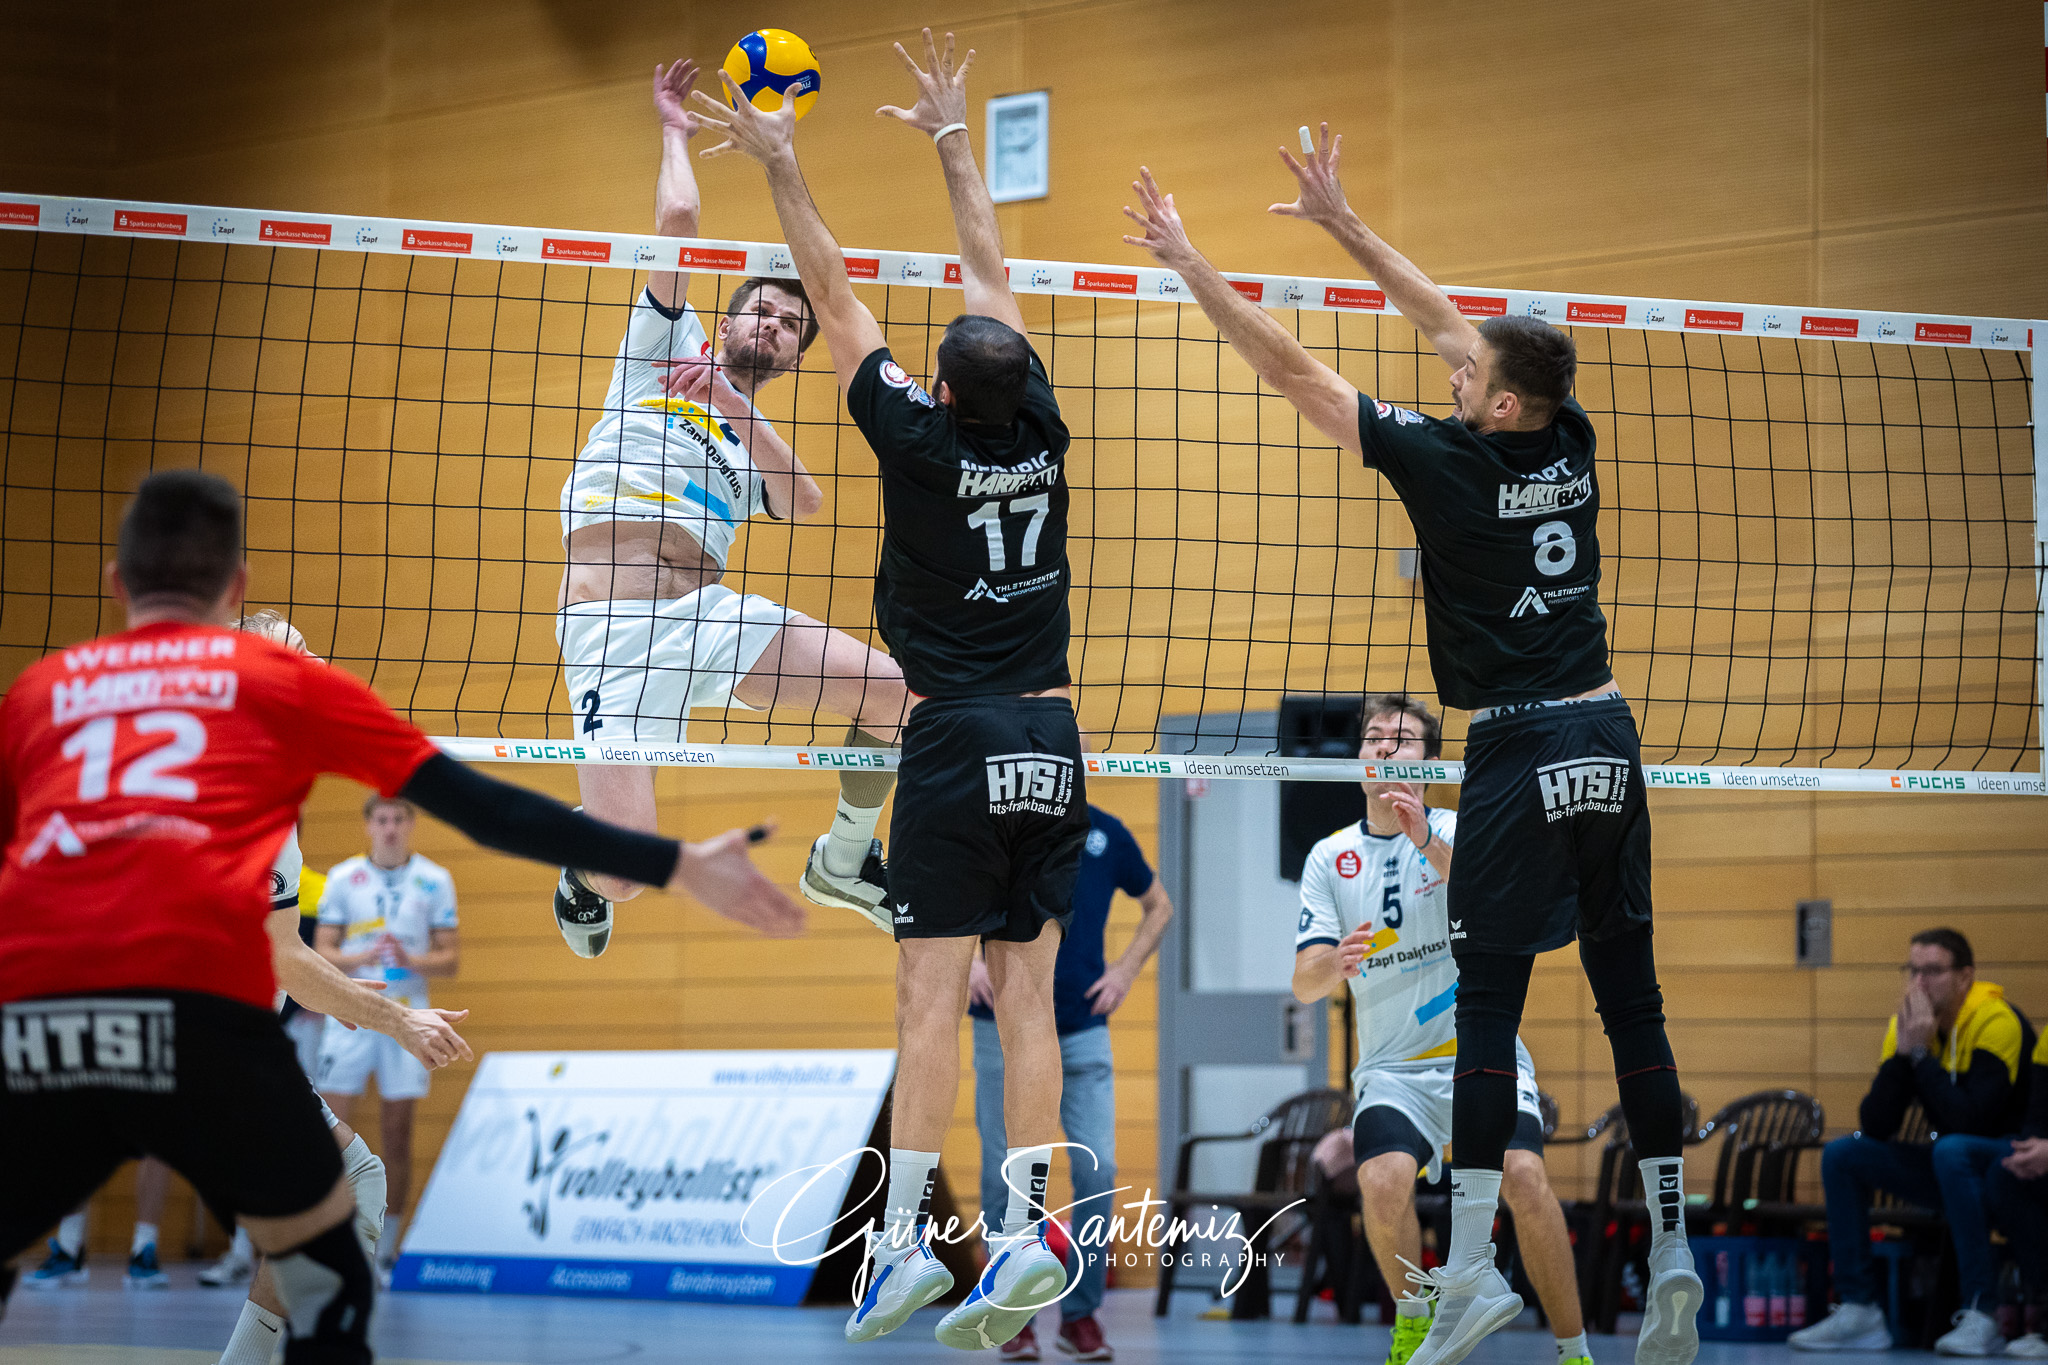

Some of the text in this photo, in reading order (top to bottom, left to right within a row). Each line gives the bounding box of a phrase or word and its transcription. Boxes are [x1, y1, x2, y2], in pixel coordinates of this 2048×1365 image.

[72, 216, 88, 225] Zapf
[130, 220, 182, 230] Sparkasse Nürnberg
[275, 230, 326, 240] Sparkasse Nürnberg
[556, 248, 581, 256] Sparkasse
[775, 262, 790, 270] Zapf
[908, 269, 922, 278] Zapf
[1360, 297, 1381, 305] Nürnberg
[679, 419, 709, 447] Zapf
[968, 493, 1049, 572] 17
[1533, 520, 1576, 576] 8
[64, 636, 236, 672] WERNER
[582, 690, 603, 734] 2
[62, 711, 207, 802] 12
[516, 746, 714, 763] FUCHS Ideen umsetzen
[818, 754, 885, 767] FUCHS
[1107, 761, 1289, 777] FUCHS Ideen umsetzen
[1384, 766, 1446, 779] FUCHS
[987, 761, 1057, 802] HTS
[1539, 765, 1611, 810] HTS
[1651, 772, 1820, 787] FUCHS Ideen umsetzen
[1908, 776, 2045, 792] FUCHS Ideen umse
[1382, 884, 1403, 929] 5
[1367, 954, 1394, 969] Zapf
[2, 1015, 142, 1074] HTS
